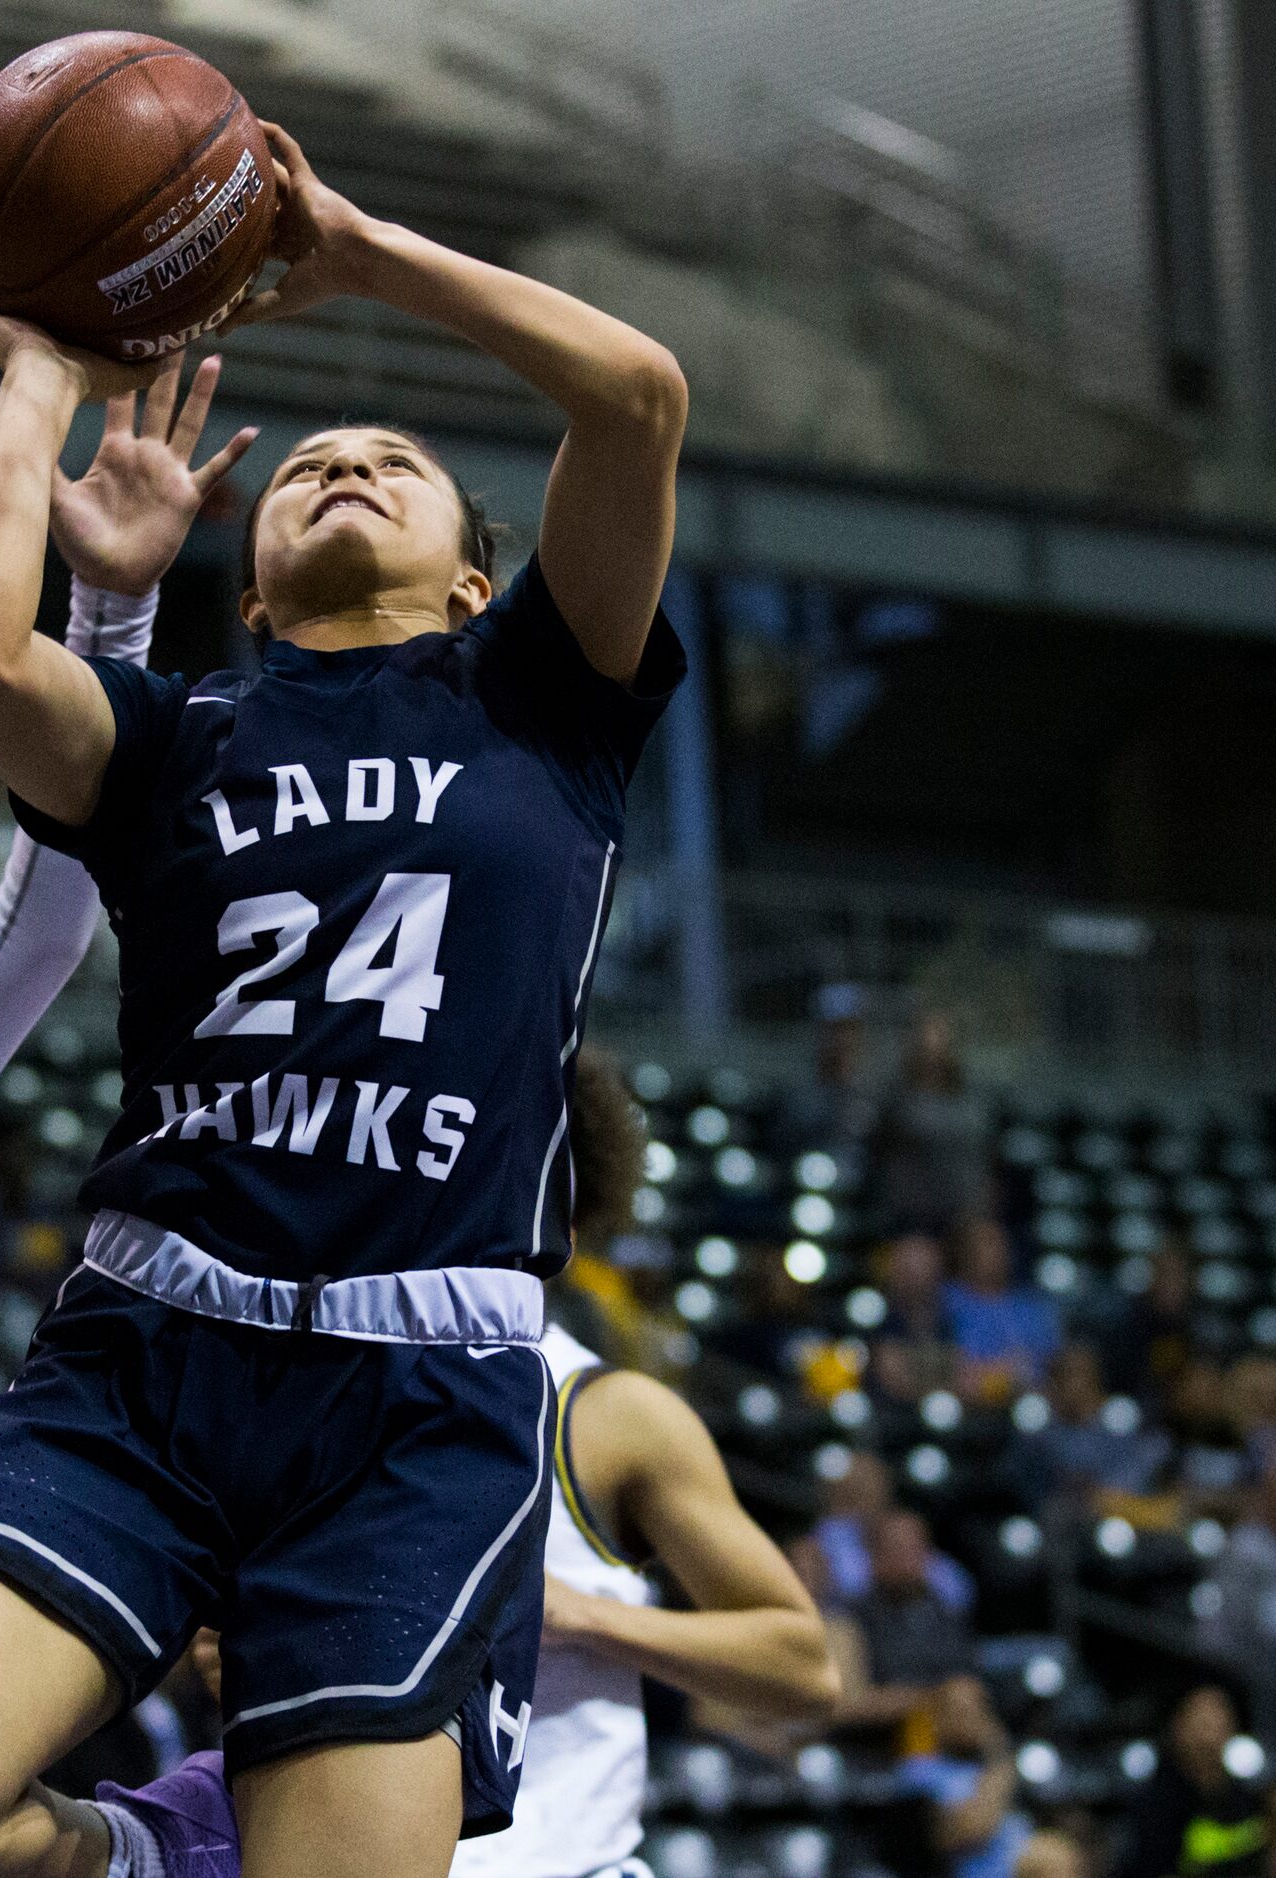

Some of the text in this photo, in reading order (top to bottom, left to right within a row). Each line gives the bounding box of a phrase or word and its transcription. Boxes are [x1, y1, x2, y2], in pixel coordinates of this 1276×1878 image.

[143, 174, 217, 243] TF-1000
[155, 161, 264, 291] PLATINUM
[200, 756, 464, 857] LADY
[193, 872, 452, 1043] 24
[136, 1071, 477, 1182] HAWKS
[488, 1679, 532, 1774] H
